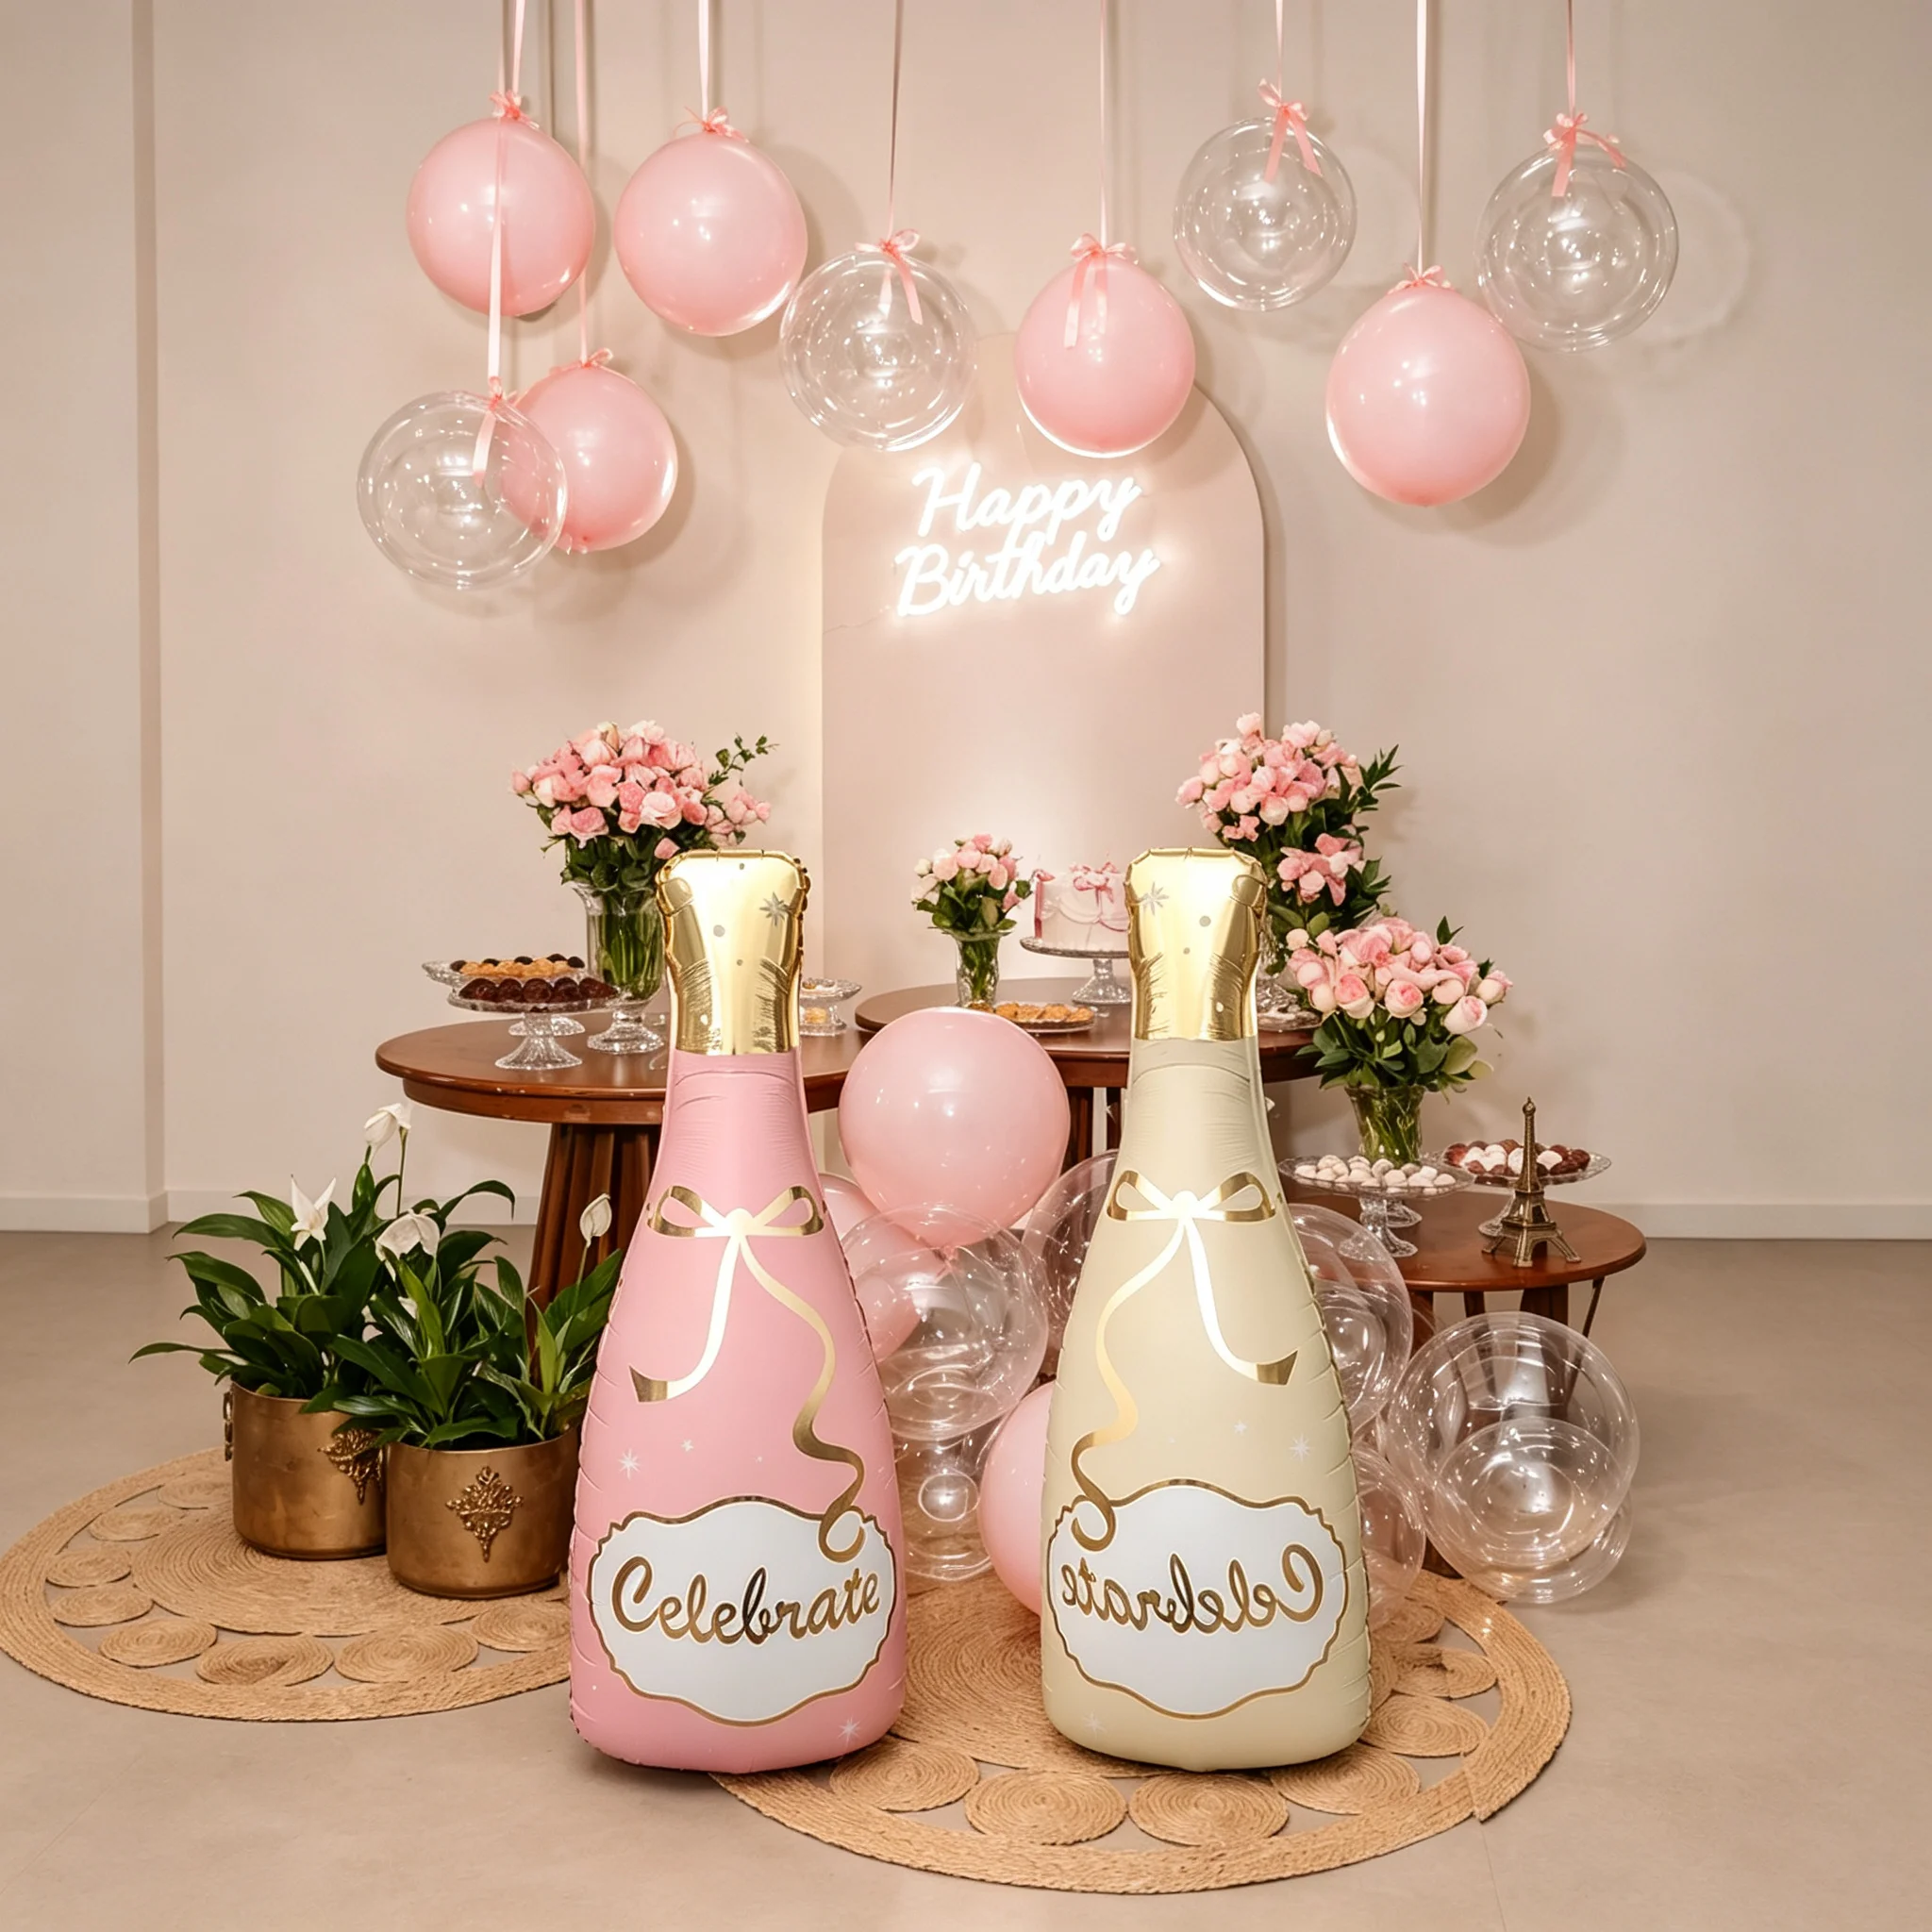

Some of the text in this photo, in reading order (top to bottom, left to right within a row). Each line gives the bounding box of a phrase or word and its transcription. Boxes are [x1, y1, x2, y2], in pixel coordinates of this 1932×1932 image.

[911, 461, 1142, 545] Happy
[894, 530, 1160, 617] Birthday
[611, 1556, 880, 1644] Celebrate
